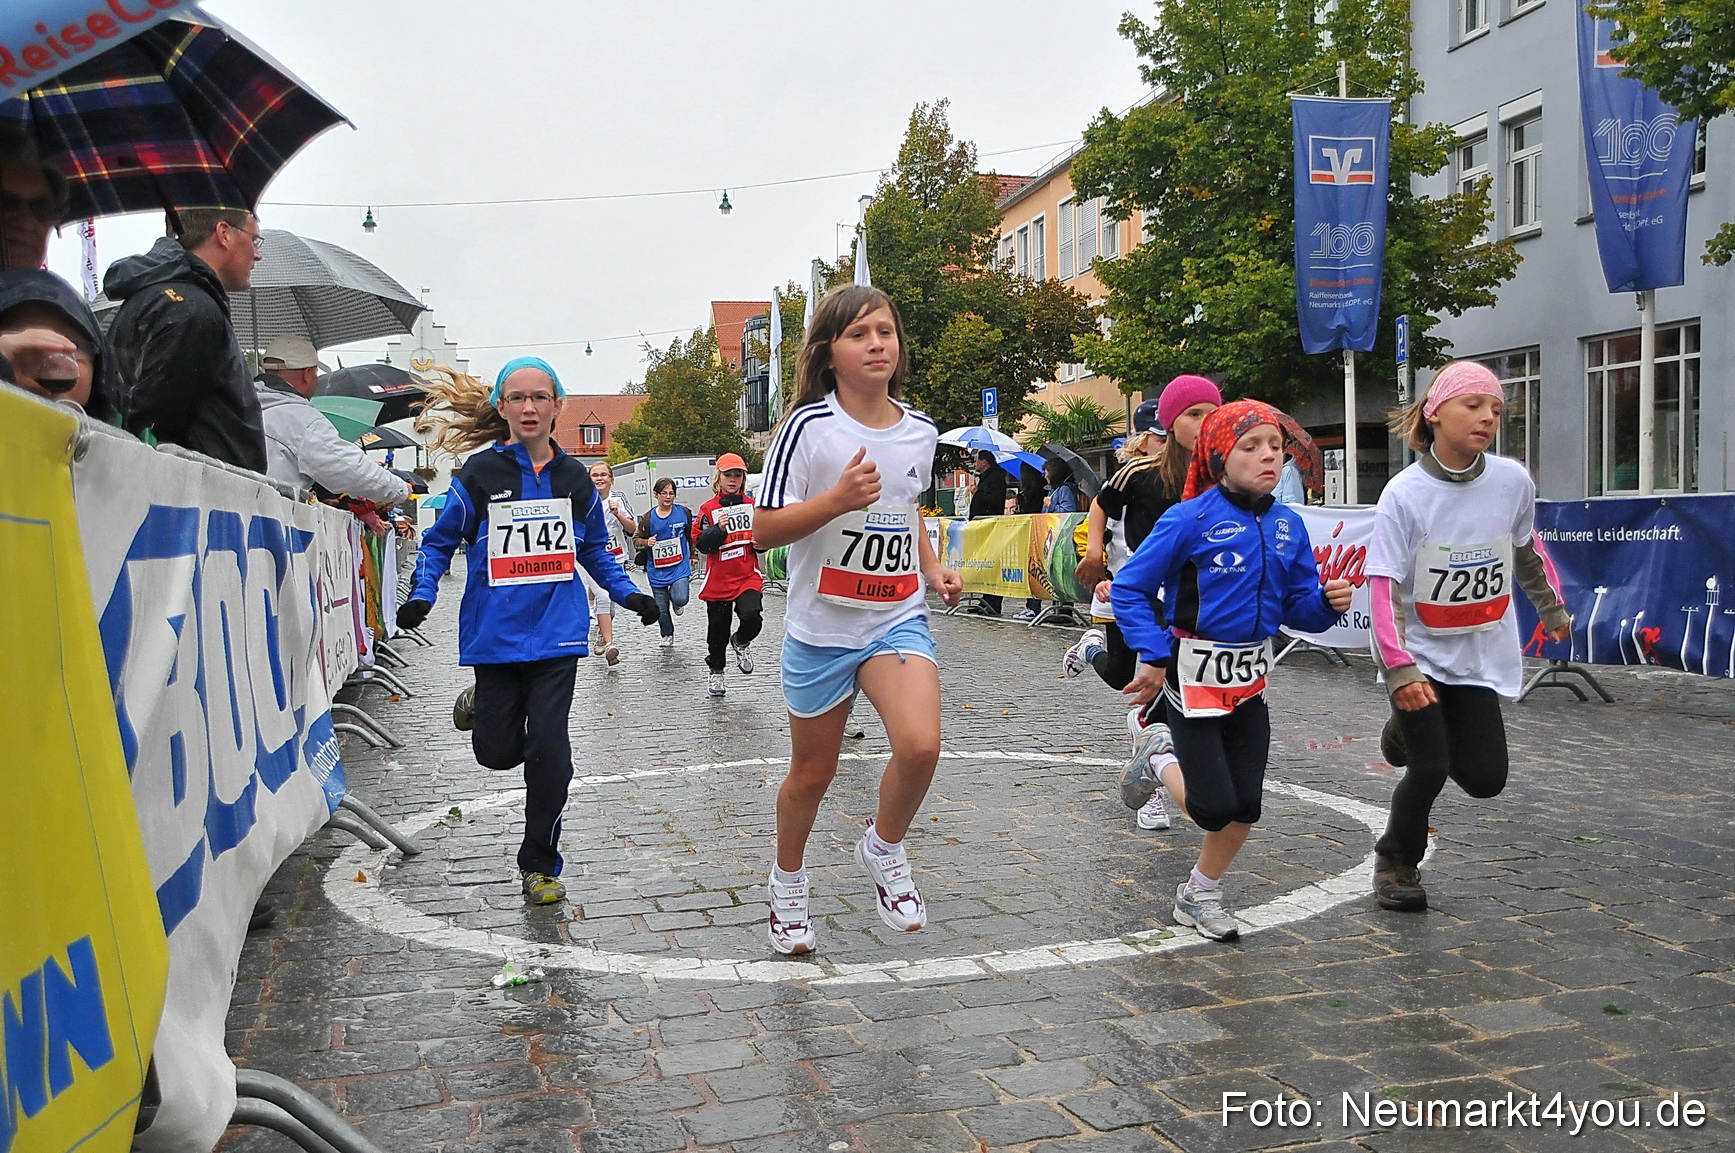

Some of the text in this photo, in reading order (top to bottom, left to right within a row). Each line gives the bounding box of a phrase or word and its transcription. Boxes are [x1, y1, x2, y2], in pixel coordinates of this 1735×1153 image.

[1651, 215, 1663, 225] eG
[1309, 222, 1375, 262] 100
[985, 391, 994, 412] P
[511, 505, 550, 516] BOCK
[866, 512, 907, 525] BOCK
[728, 514, 751, 532] 088
[497, 520, 568, 554] 7142
[1537, 524, 1684, 542] sind unsere Leidenschaft.
[655, 545, 680, 558] 7337
[840, 529, 913, 573] 7093
[1449, 547, 1493, 562] BOCK
[509, 560, 563, 575] Johanna
[825, 558, 832, 566] 5
[855, 578, 896, 598] Luisa
[1428, 562, 1504, 602] 7285
[1192, 646, 1268, 684] 7055
